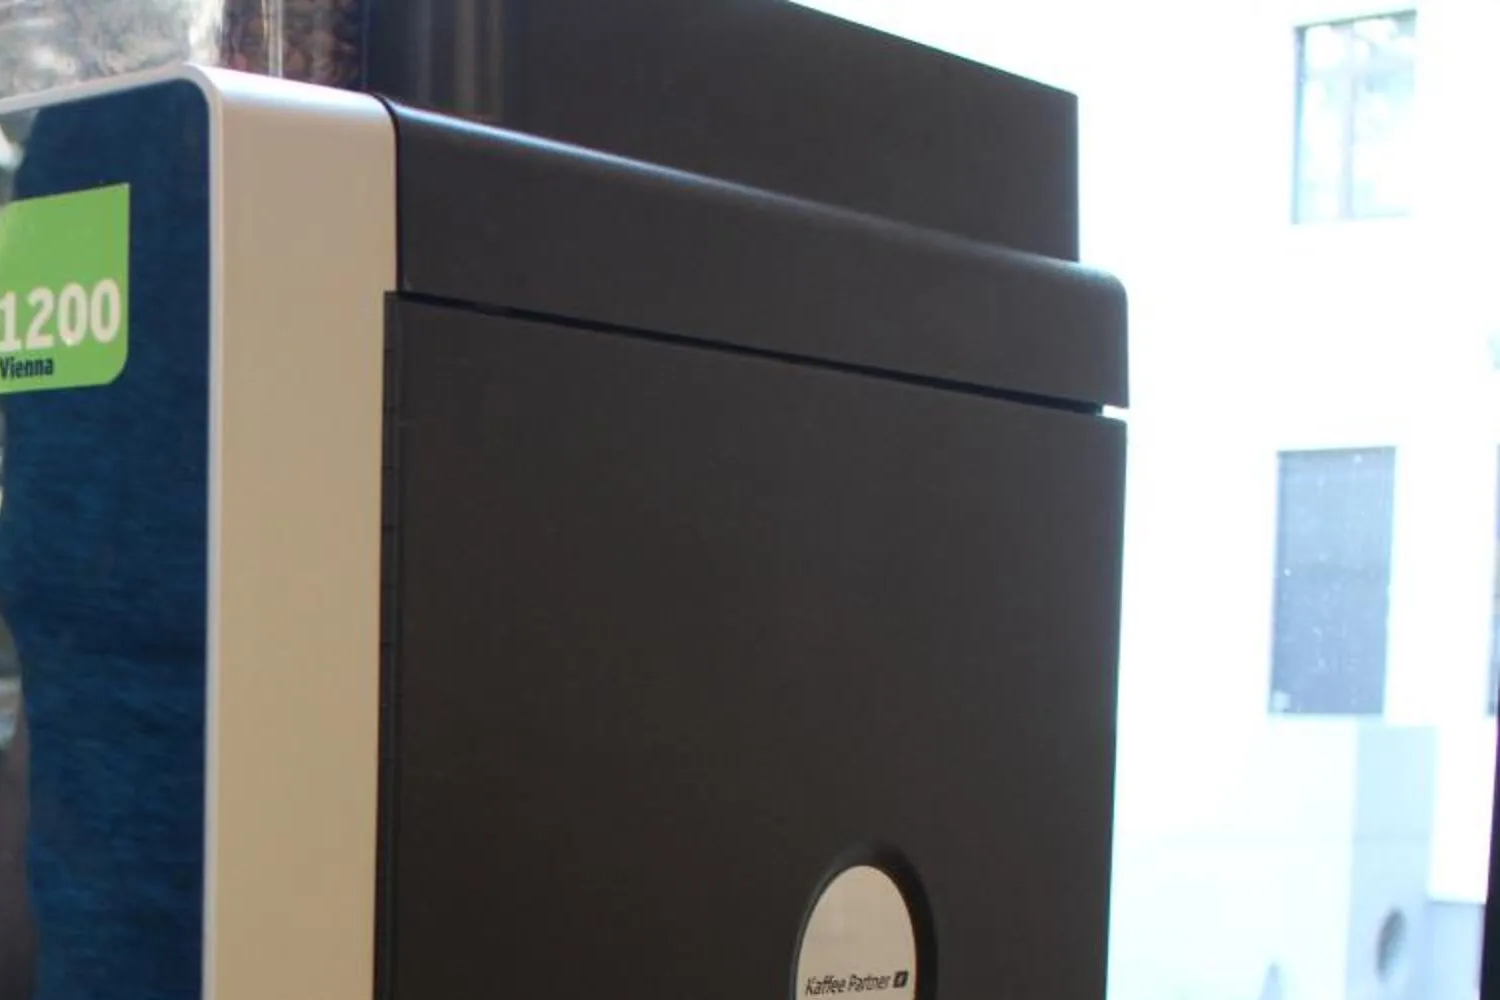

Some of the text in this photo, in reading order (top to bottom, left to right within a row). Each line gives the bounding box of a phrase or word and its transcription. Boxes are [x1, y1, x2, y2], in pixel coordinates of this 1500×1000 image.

[0, 355, 54, 380] Vienna
[805, 973, 891, 996] Kaffee Partner
